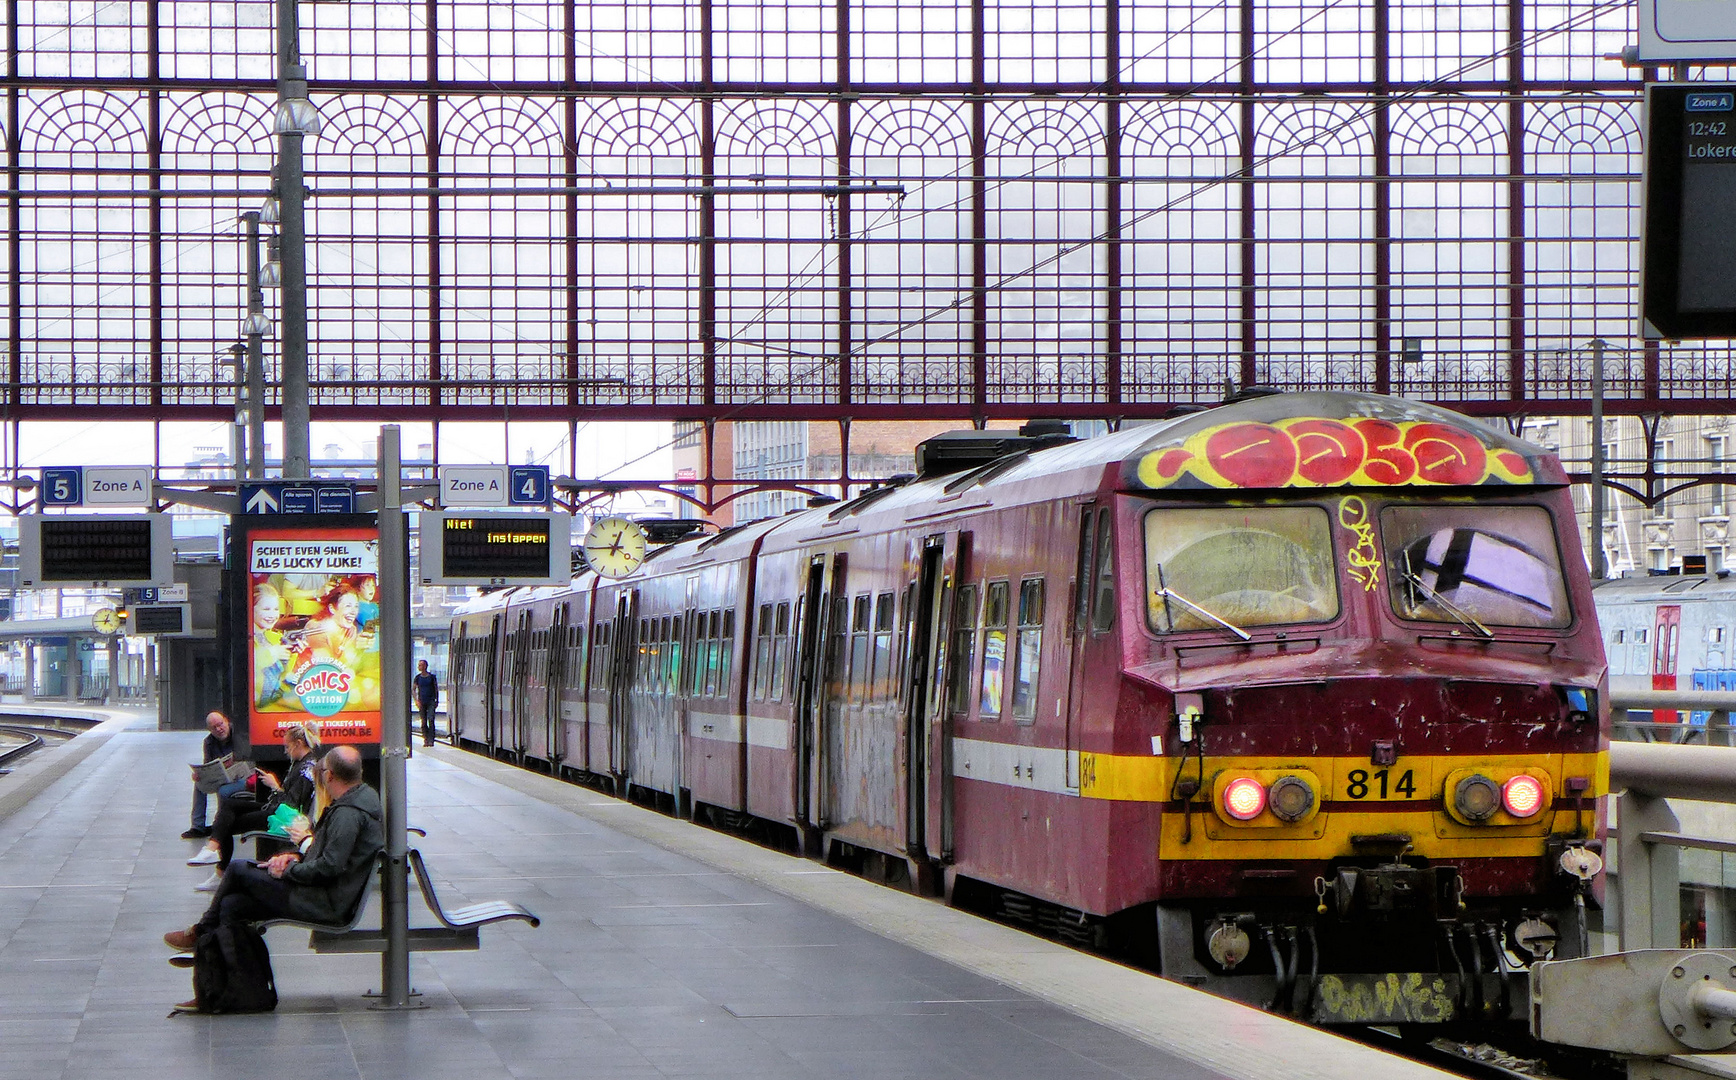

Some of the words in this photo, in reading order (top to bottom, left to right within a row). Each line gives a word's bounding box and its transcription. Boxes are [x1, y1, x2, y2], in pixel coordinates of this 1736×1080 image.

[1692, 97, 1717, 107] Zone
[1719, 97, 1728, 107] A
[1688, 121, 1727, 136] 12:42
[53, 479, 69, 500] 5
[92, 480, 128, 492] Zone
[132, 480, 143, 492] A
[450, 479, 485, 491] Zone
[489, 479, 499, 491] A
[521, 478, 536, 499] 4
[446, 519, 473, 530] Niet
[487, 532, 546, 543] instappen
[256, 547, 293, 556] SCHIET
[295, 546, 321, 556] EVEN
[323, 546, 350, 555] SNEL
[256, 558, 280, 569] ALS
[284, 558, 323, 569] LUCKY
[326, 557, 362, 569] LUKE!
[145, 589, 153, 599] 5
[305, 695, 343, 704] STATION
[277, 720, 304, 729] BESTEL
[325, 719, 352, 728] TICKETS
[354, 719, 366, 727] VIA
[1083, 757, 1096, 789] 814
[1346, 769, 1416, 800] 814
